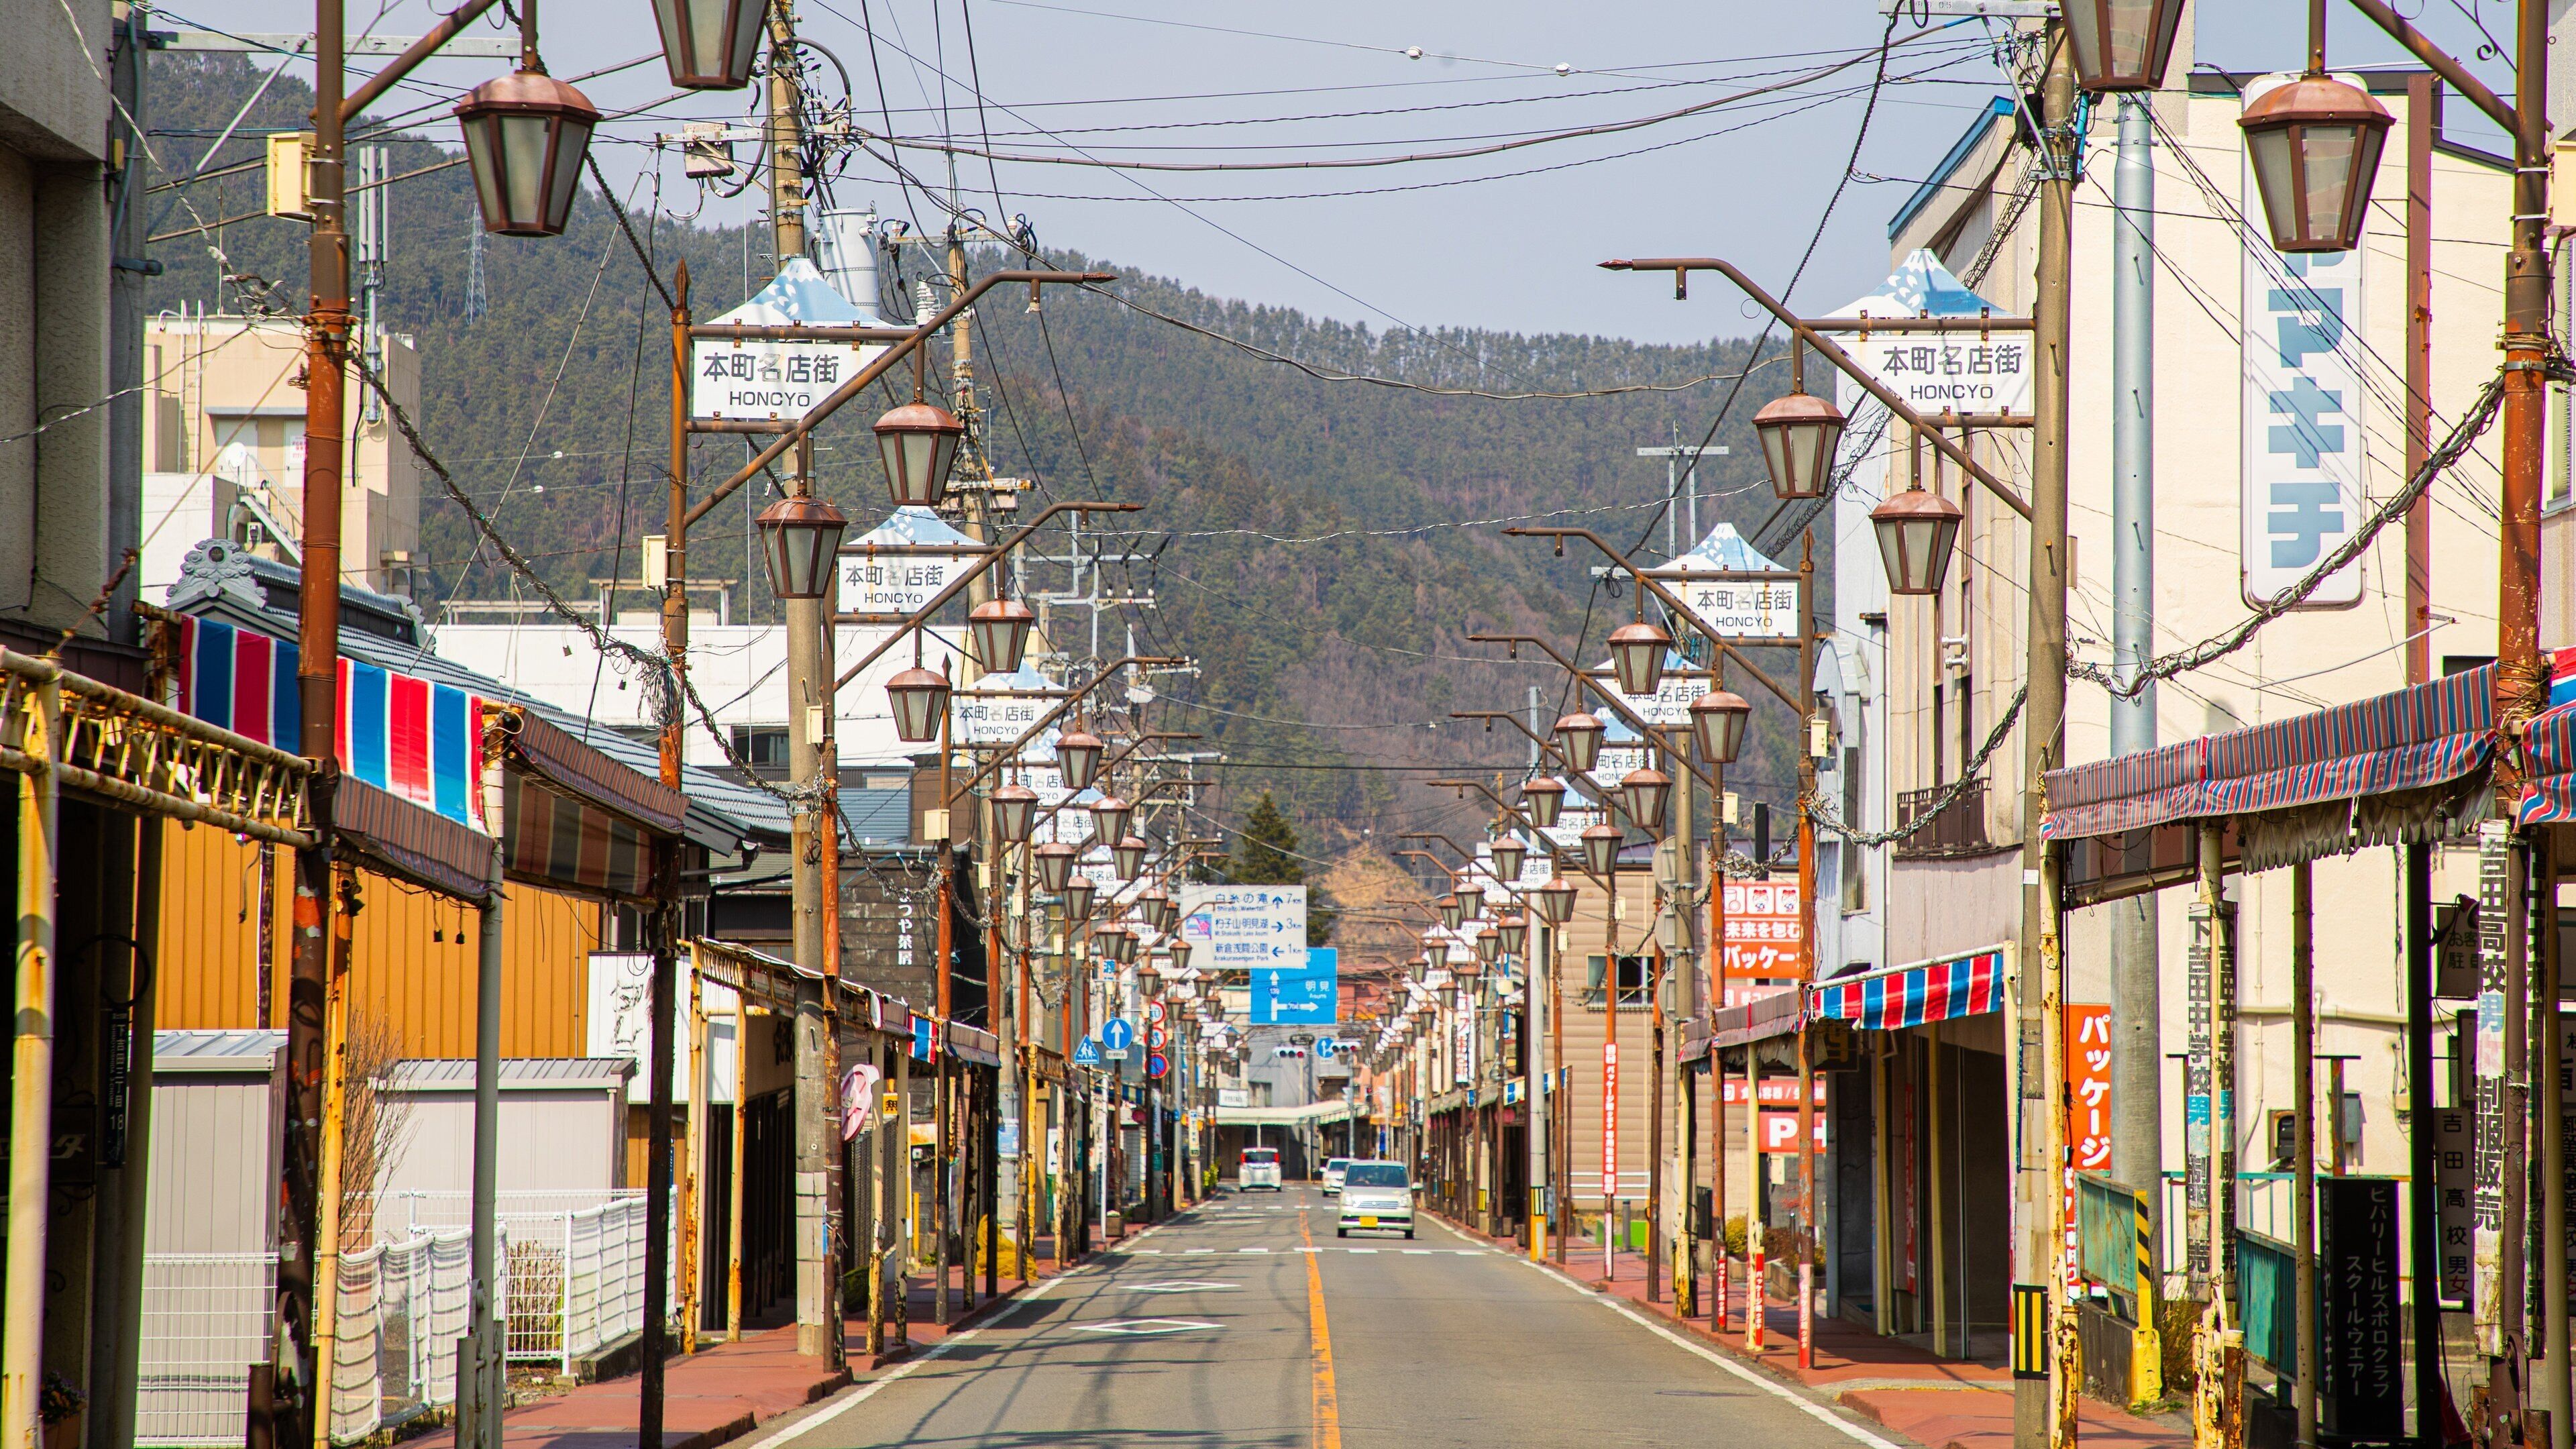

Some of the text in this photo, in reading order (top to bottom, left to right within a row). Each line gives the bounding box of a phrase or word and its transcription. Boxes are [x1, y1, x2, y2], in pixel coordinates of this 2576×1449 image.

[703, 352, 839, 383] 本町名店街
[1883, 345, 2021, 376] 本町名店街
[2268, 253, 2347, 568] マキチ
[845, 565, 943, 586] 本町名店街
[1697, 590, 1792, 610] 本町名店街
[959, 705, 1034, 721] 本町名店街
[1216, 894, 1268, 904] 白糸の滝
[1725, 921, 1800, 938] 未来を包む
[1725, 945, 1800, 969] パッケー
[1305, 981, 1330, 991] 明見
[109, 1114, 124, 1130] 18
[2369, 1187, 2390, 1398] ビバリーヒルズポロクラブ
